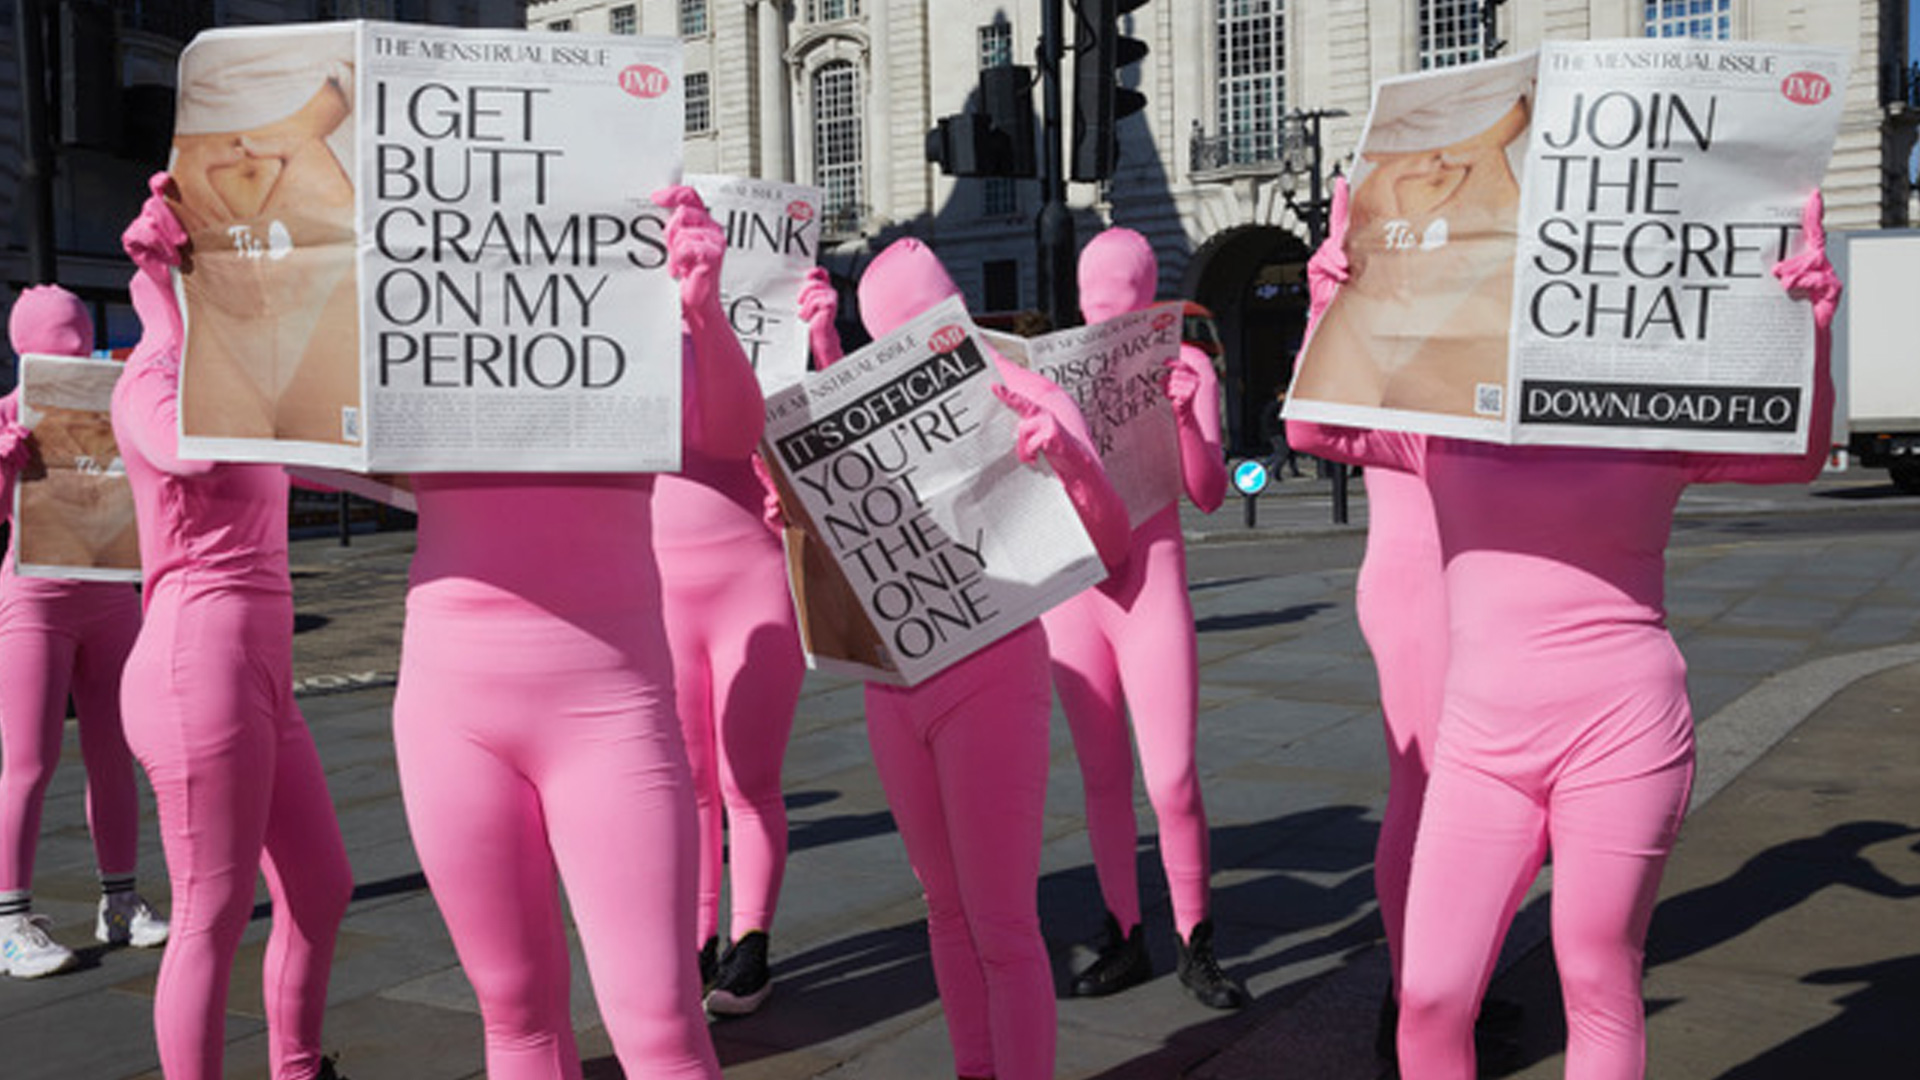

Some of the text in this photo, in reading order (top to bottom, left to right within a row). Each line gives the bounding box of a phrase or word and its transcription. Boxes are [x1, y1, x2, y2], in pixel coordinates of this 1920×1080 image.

[375, 37, 610, 67] THE MENSTRUAL ISSUE
[1552, 52, 1776, 74] THE MENSTRUAL ISSUE
[376, 81, 552, 142] I GET
[1542, 91, 1717, 152] JOIN
[376, 143, 564, 206] BUTT
[1540, 154, 1684, 215] THE
[375, 206, 669, 270] CRAMPS
[1533, 217, 1804, 279] SECRET
[375, 267, 609, 328] ON MY
[1530, 279, 1730, 341] CHAT
[378, 331, 627, 390] PERIOD
[785, 351, 980, 466] IT'S OFFICIAL
[1527, 388, 1791, 425] DOWNLOAD FLO
[798, 391, 981, 506] YOU'RE
[823, 466, 924, 550] NOT
[842, 508, 950, 584] THE
[872, 527, 987, 622] ONLY
[894, 577, 1000, 659] ONE
